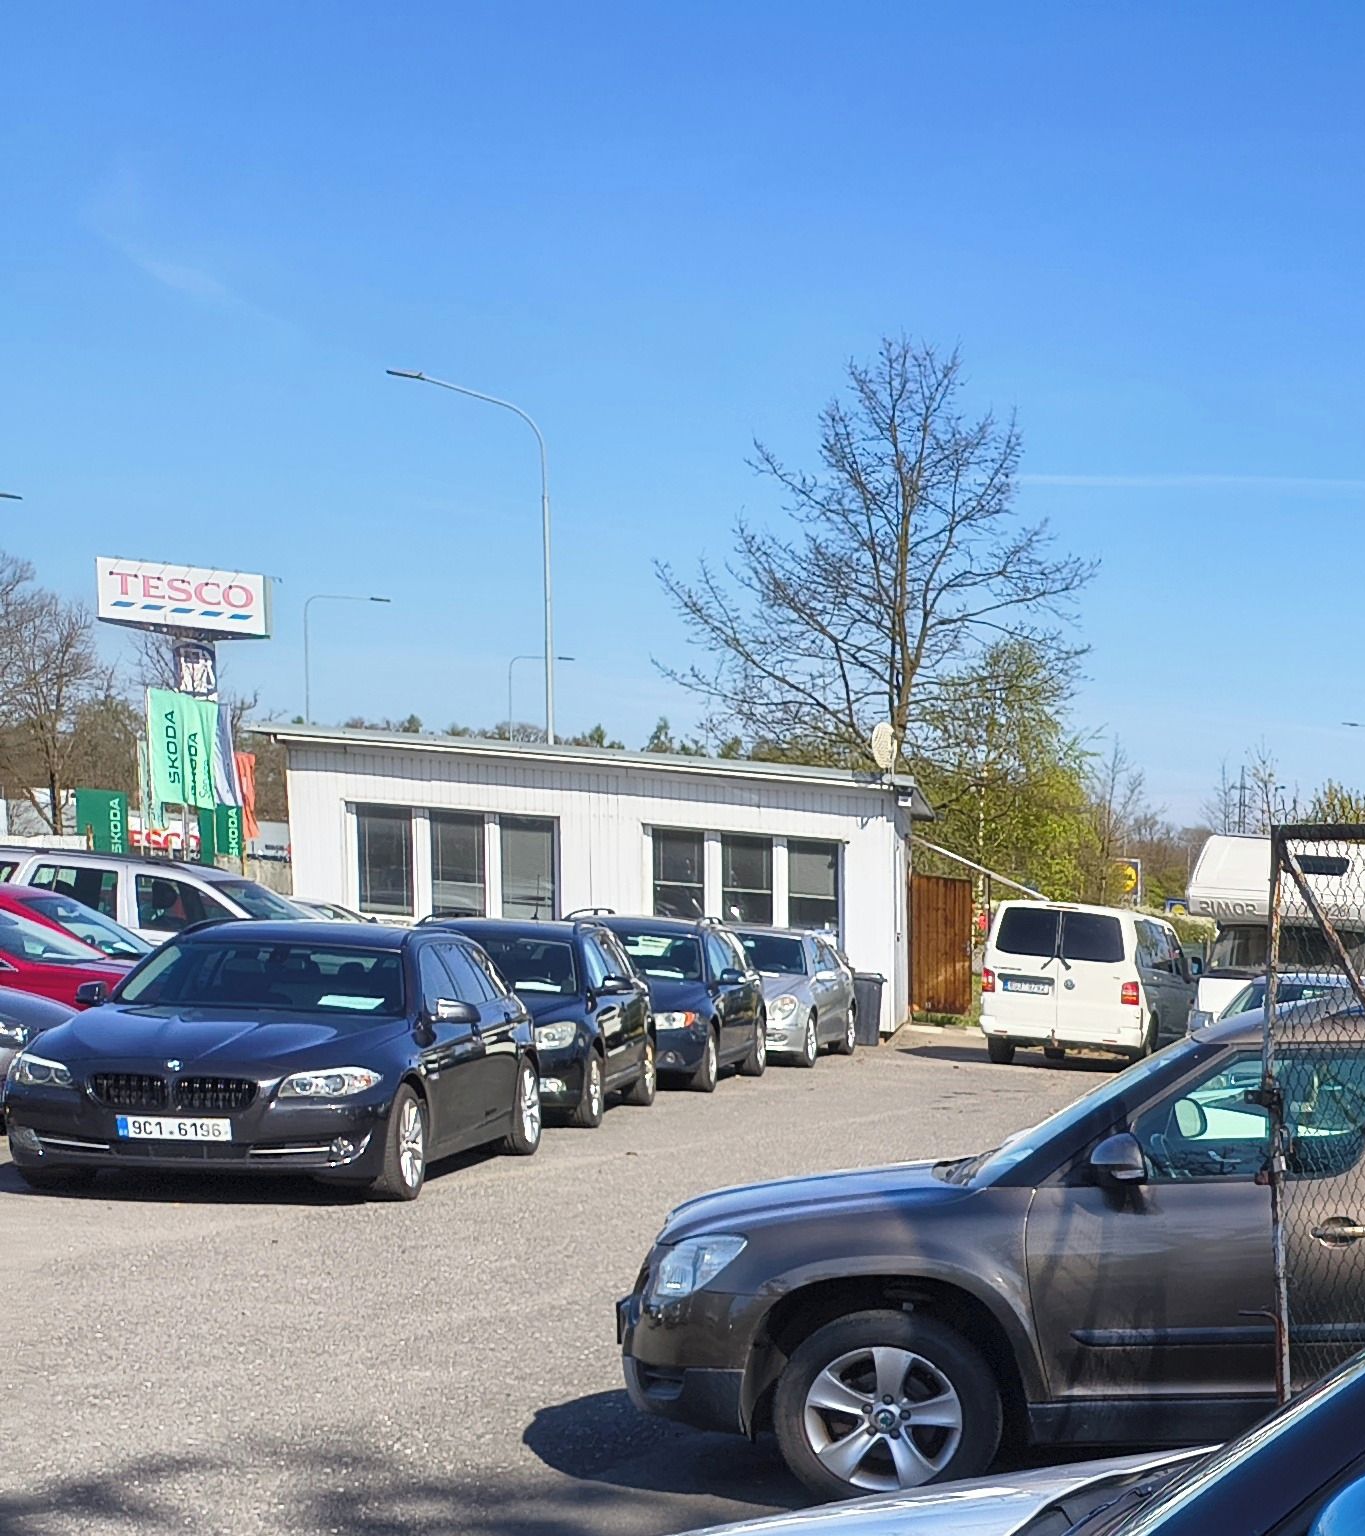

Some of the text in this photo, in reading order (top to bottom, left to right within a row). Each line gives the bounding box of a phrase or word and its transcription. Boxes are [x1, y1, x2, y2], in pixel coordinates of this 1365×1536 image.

[109, 571, 254, 609] TESCO
[1199, 900, 1258, 917] RIMOR
[132, 1120, 164, 1136] 9C1
